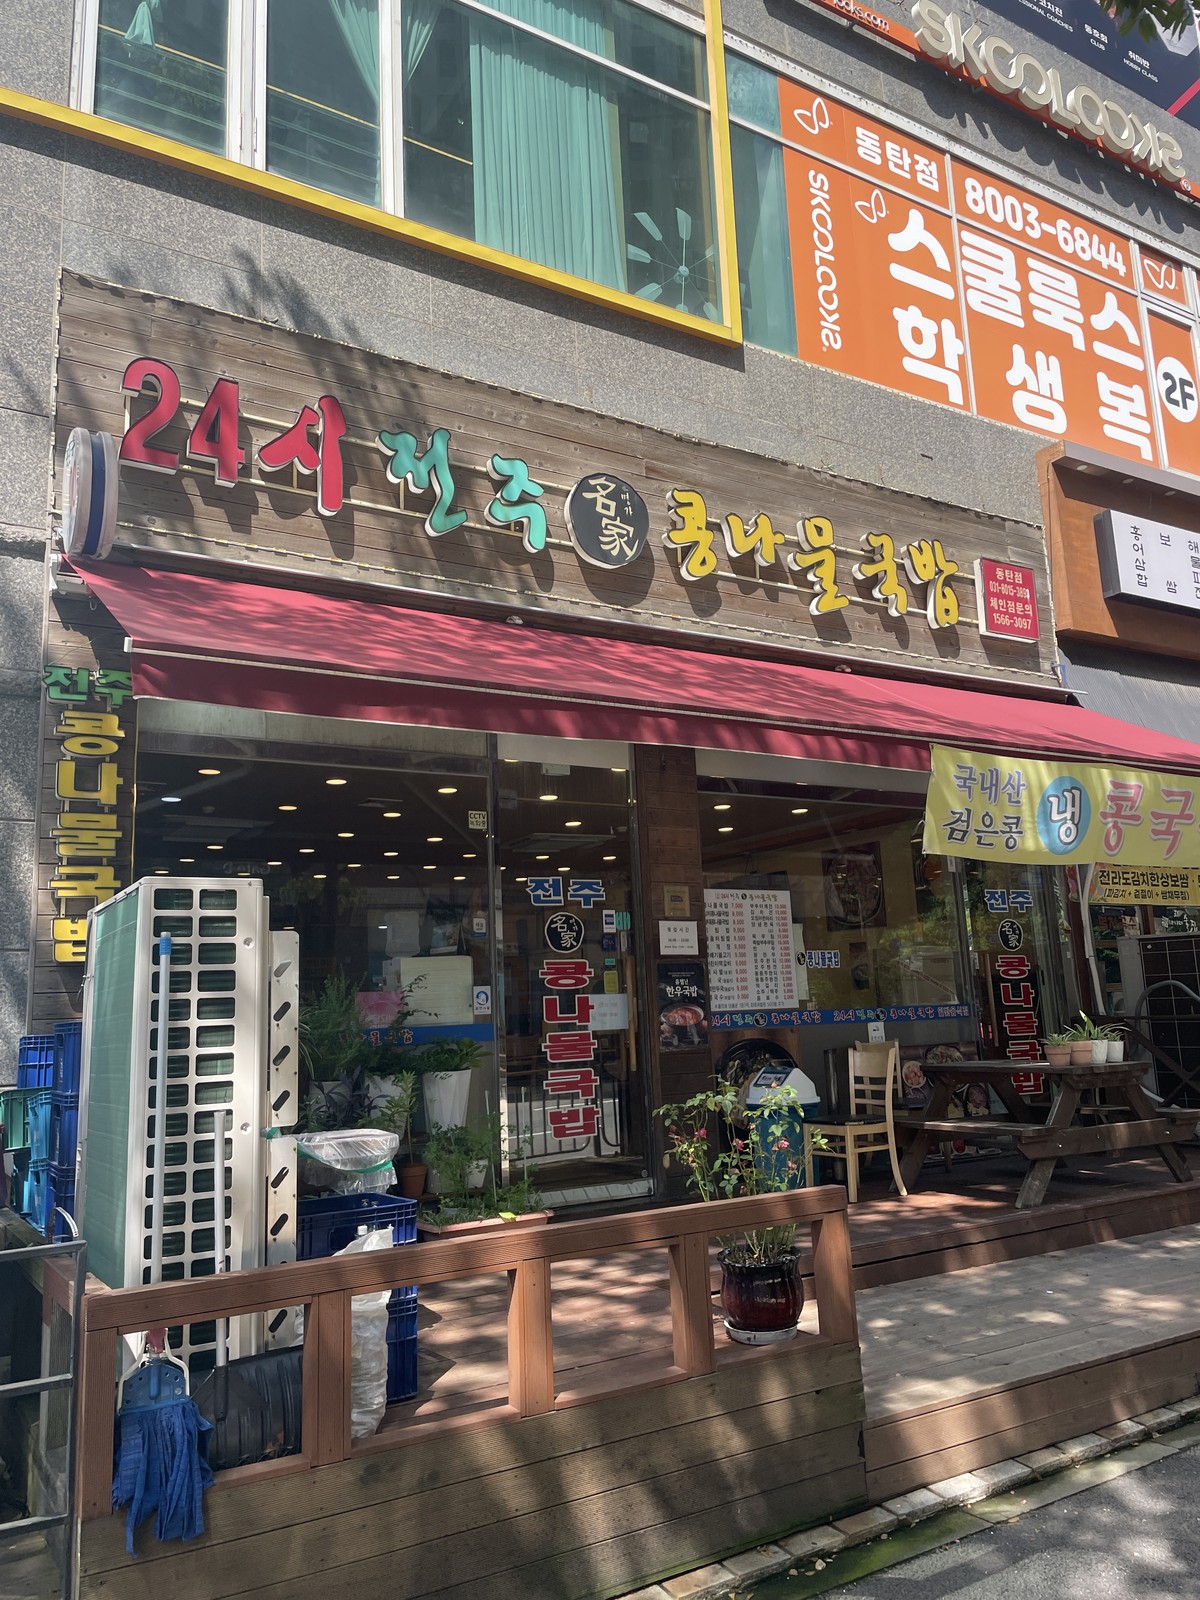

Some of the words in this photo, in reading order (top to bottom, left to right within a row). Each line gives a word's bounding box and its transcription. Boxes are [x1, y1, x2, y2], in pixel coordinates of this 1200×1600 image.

[834, 0, 889, 31] ooks.com
[1084, 23, 1109, 44] 동호회
[1090, 38, 1106, 51] CLUB
[1128, 50, 1150, 69] 취미반
[1123, 57, 1141, 73] HOBBY
[1141, 67, 1159, 83] CLASS
[855, 126, 940, 193] 동탄점
[964, 177, 1127, 277] 8003-6844
[887, 208, 1145, 372] 스쿨룩스
[892, 304, 1153, 462] 학생복
[1162, 370, 1195, 411] 2F
[119, 357, 347, 516] 24시
[376, 428, 548, 553] 전주
[581, 476, 640, 561] 名家
[664, 487, 960, 630] 콩나물국밥
[1130, 525, 1148, 588] 홍어삼합
[995, 567, 1023, 584] 동탄점
[990, 596, 1033, 617] 체인점문의
[993, 612, 1032, 630] 1566-3097
[43, 665, 132, 706] 전주
[953, 763, 1027, 806] 국내산
[469, 812, 486, 820] CCTV
[942, 807, 1025, 852] 검은콩
[1047, 785, 1081, 846] 냉
[1098, 778, 1200, 860] 콩국
[525, 876, 606, 908] 전주
[1099, 869, 1189, 889] 전라도김치한상보쌈
[984, 889, 1034, 913] 전주
[806, 949, 841, 968] 콩나물국밥
[665, 985, 698, 998] 한우국밥
[539, 959, 601, 1140] 콩나물국밥
